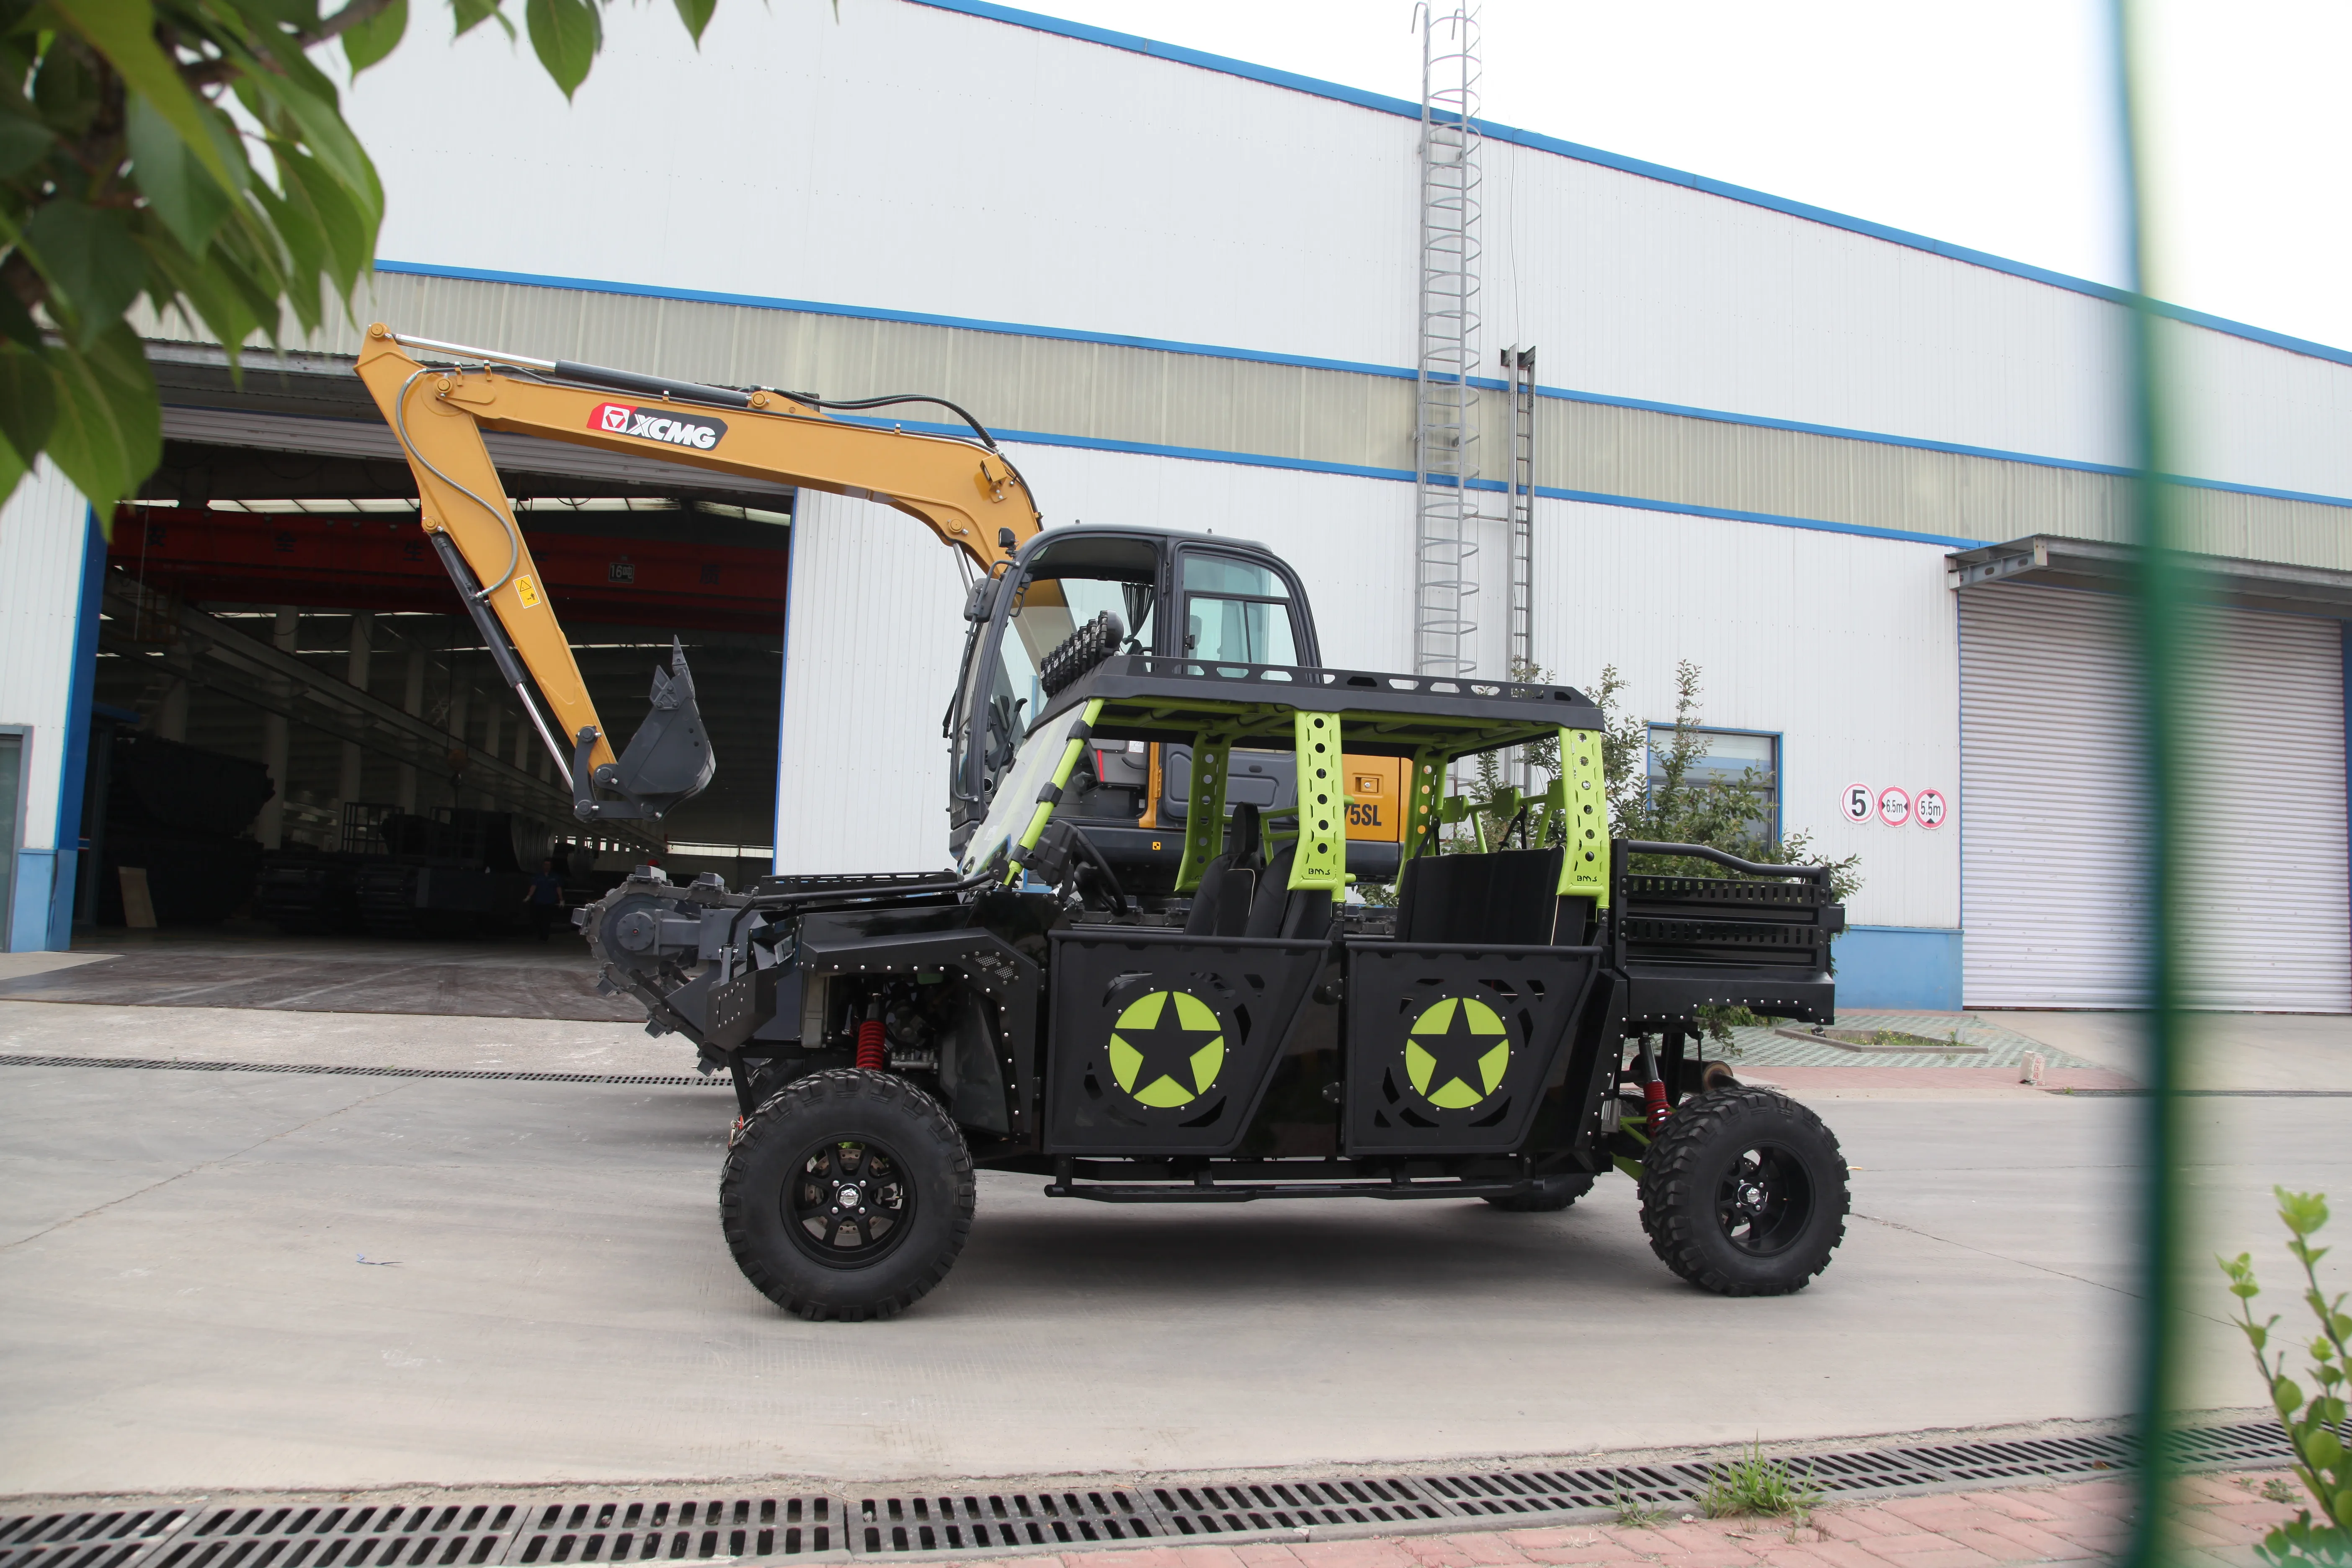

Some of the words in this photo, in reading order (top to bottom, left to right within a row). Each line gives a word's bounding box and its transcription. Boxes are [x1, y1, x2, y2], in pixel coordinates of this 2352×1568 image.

[626, 414, 716, 449] XCMG
[1852, 789, 1866, 816] 5
[1886, 799, 1903, 813] 6.5m
[1921, 801, 1941, 816] 5.5m
